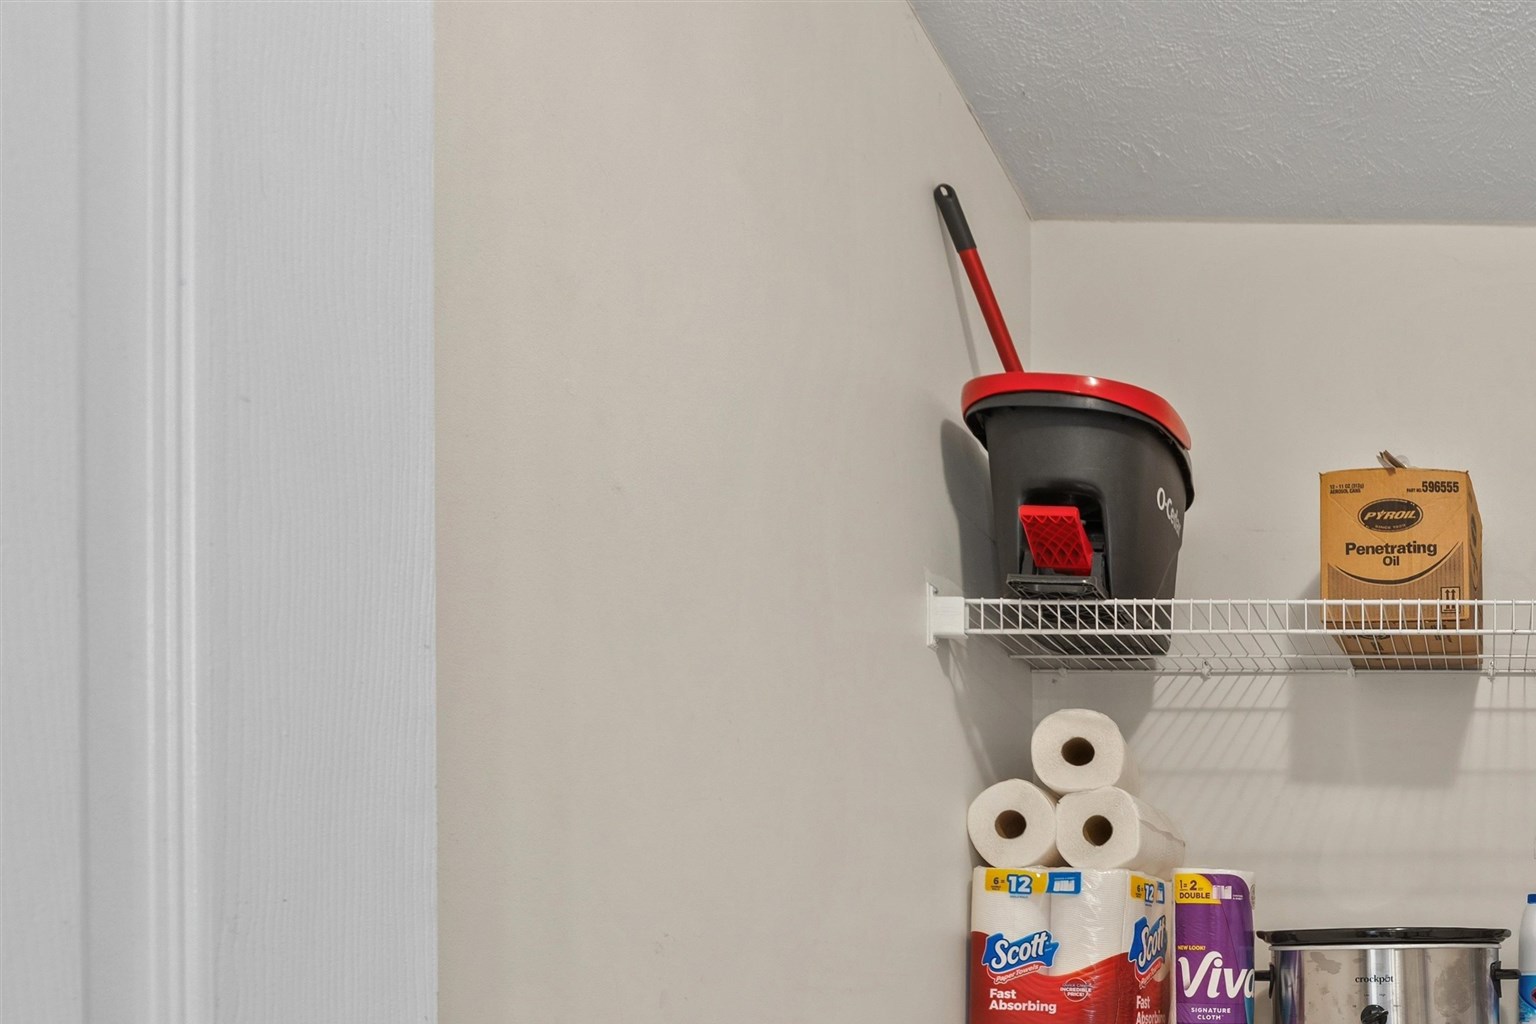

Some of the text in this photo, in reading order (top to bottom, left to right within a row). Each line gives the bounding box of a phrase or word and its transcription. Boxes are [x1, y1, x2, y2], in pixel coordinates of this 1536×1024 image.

[1422, 481, 1459, 493] 596555
[1363, 510, 1417, 521] PYROIL
[1345, 541, 1437, 556] Penetrating
[1382, 555, 1400, 566] Oil
[1007, 875, 1032, 893] 12
[1189, 880, 1197, 891] 2
[1144, 884, 1154, 901] 12
[1139, 916, 1166, 967] Scott
[991, 932, 1048, 969] Scott
[995, 964, 1040, 983] Paper Towels
[1354, 975, 1394, 985] crockpot
[990, 988, 1017, 999] Fast
[989, 1000, 1057, 1014] Absorbing
[1136, 995, 1150, 1009] Fast
